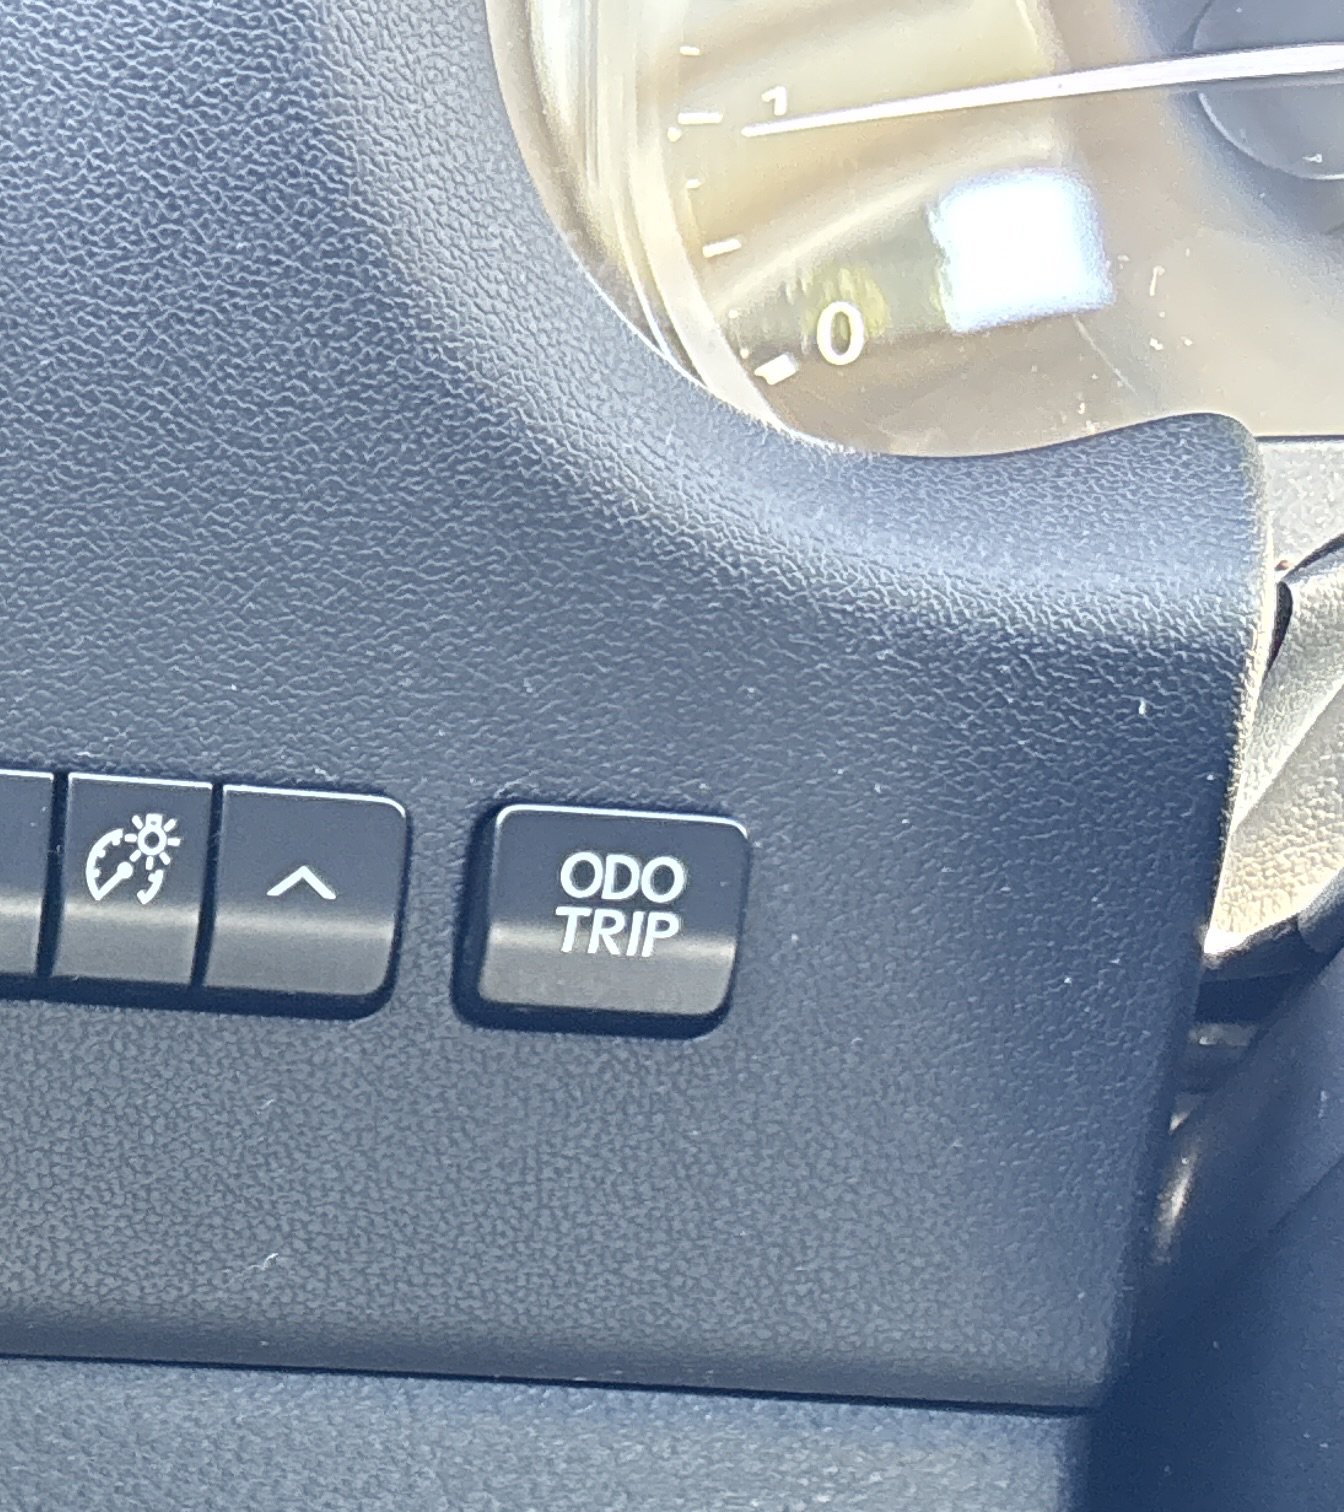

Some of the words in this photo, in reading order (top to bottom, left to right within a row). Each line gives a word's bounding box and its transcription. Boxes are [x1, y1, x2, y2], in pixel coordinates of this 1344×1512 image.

[762, 85, 788, 117] 1
[816, 300, 864, 366] 0
[560, 851, 686, 904] ODO
[555, 906, 680, 958] TRIP
